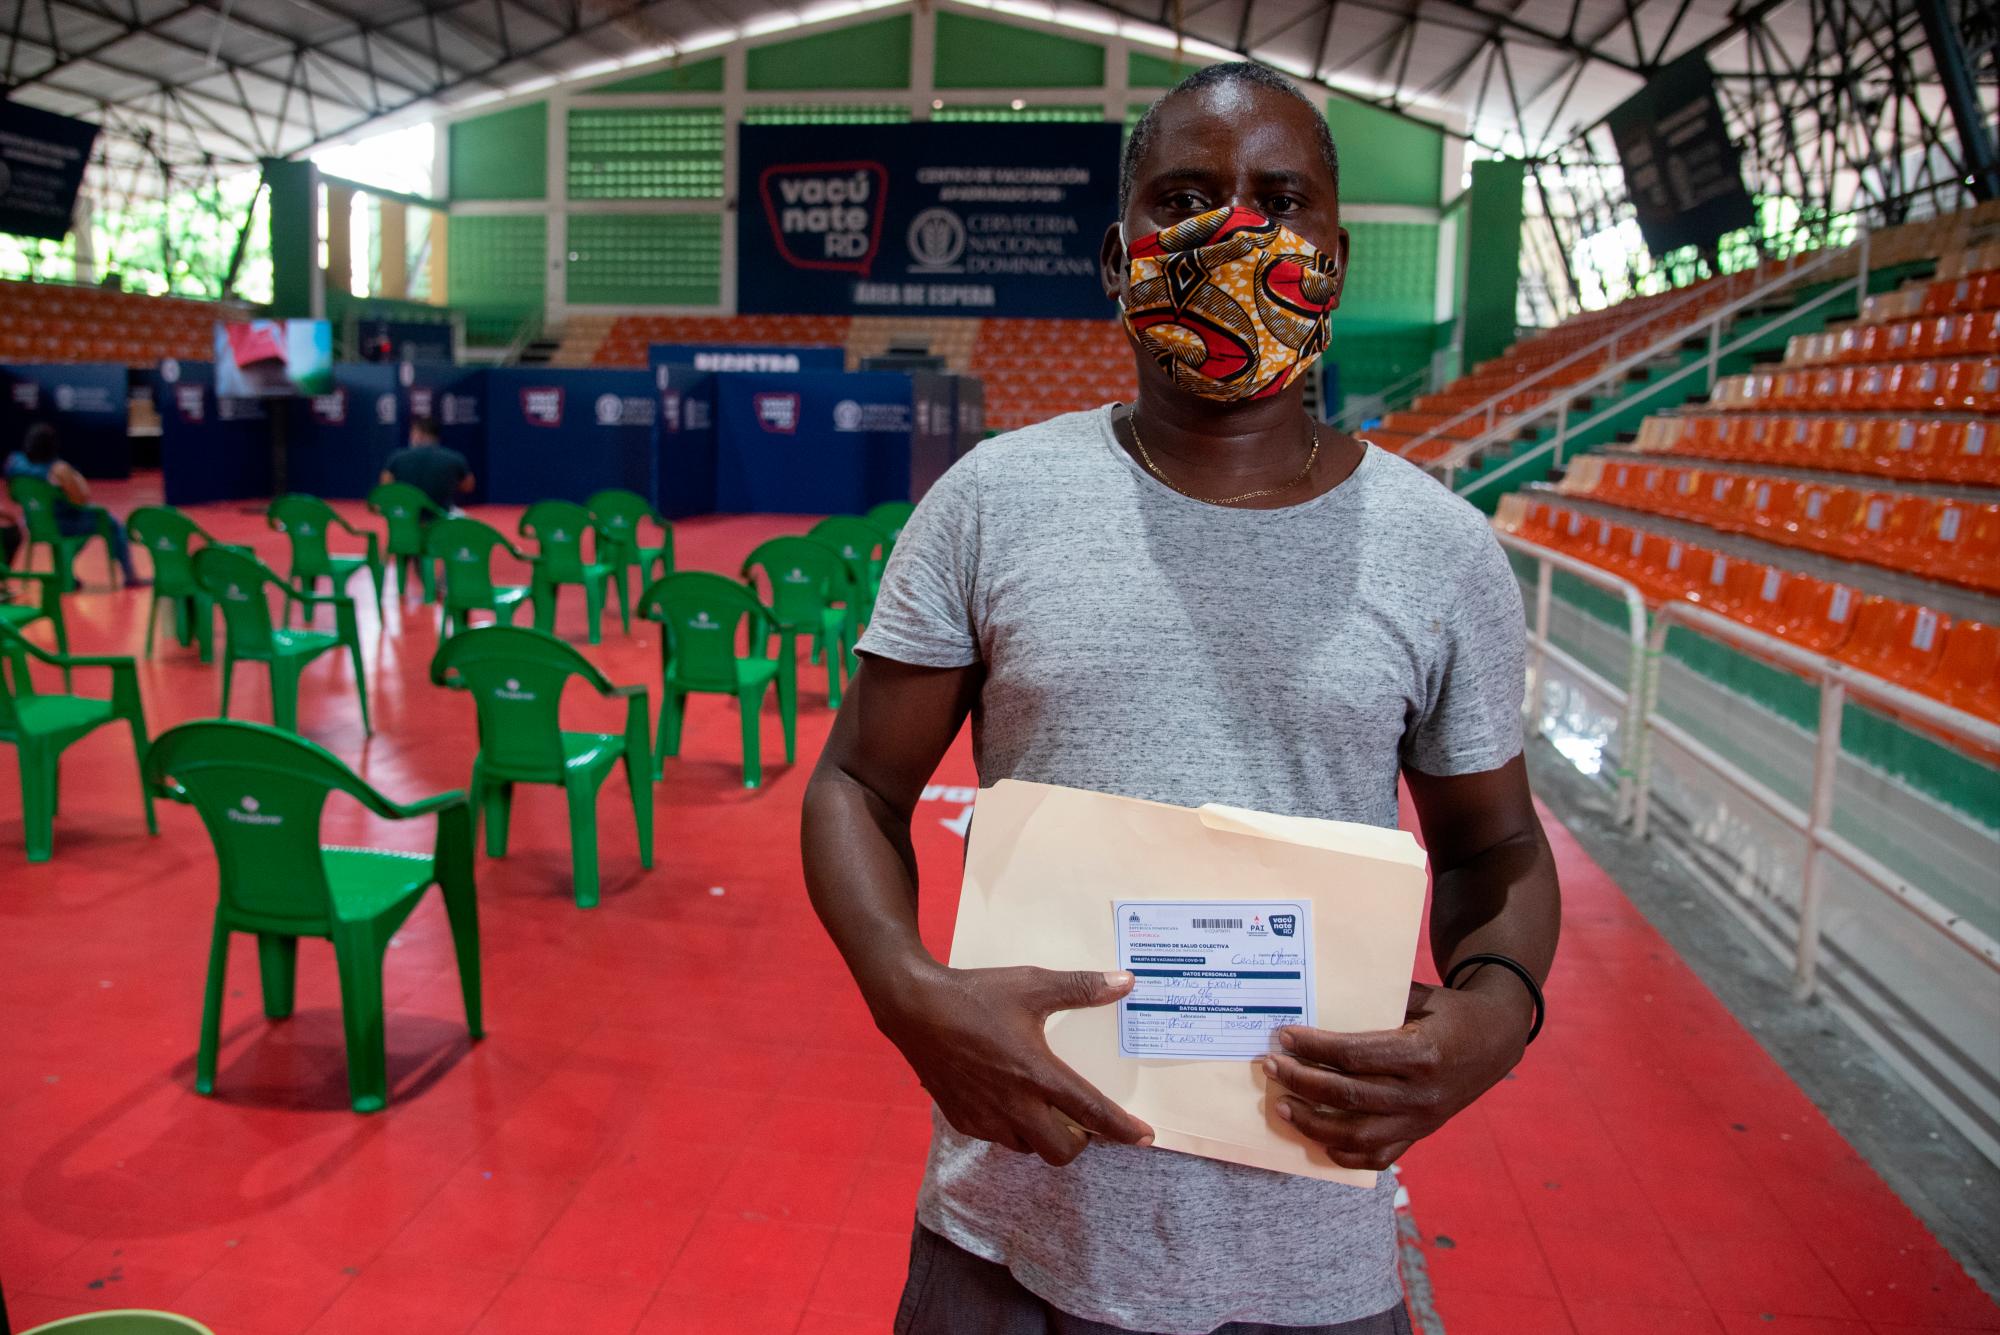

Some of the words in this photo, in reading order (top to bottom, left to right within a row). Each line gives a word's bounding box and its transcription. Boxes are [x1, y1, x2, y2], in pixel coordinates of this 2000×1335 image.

[779, 170, 869, 204] vacú
[782, 203, 868, 233] nate
[824, 232, 869, 257] RD
[967, 236, 1064, 254] NACIONAL
[966, 255, 1096, 275] DOMINICANA
